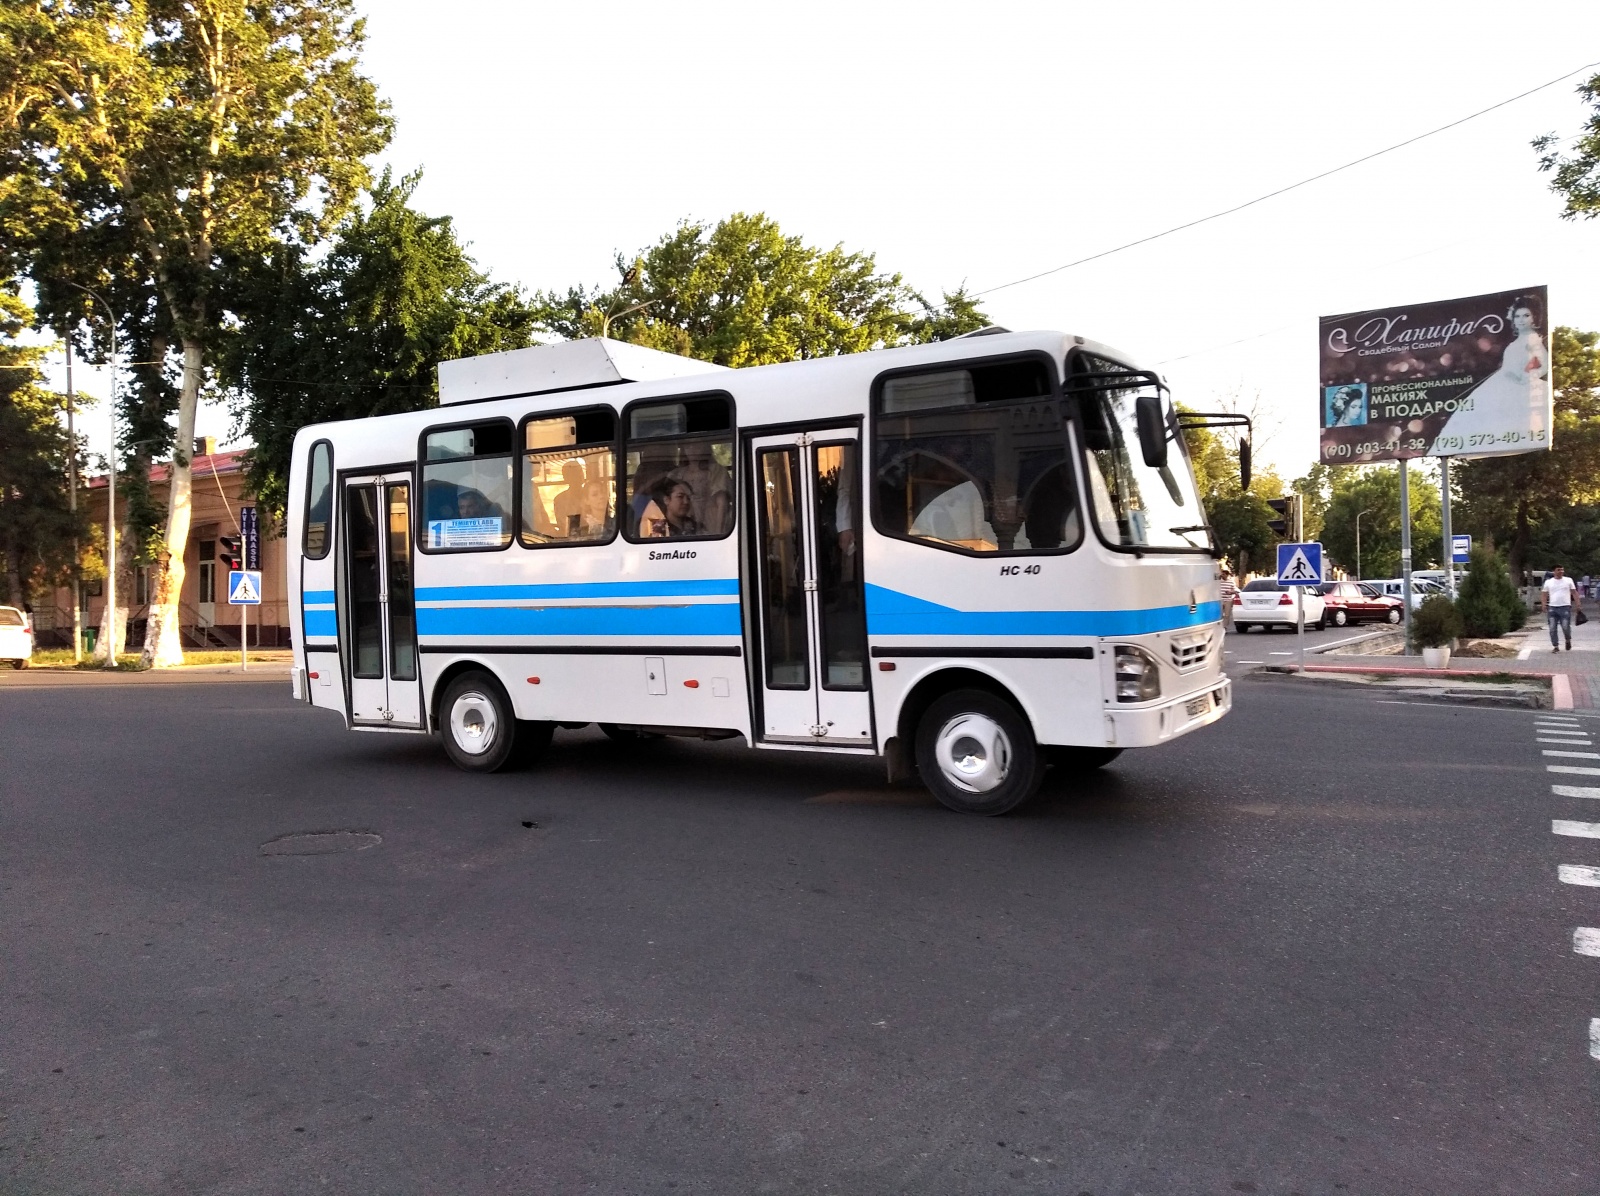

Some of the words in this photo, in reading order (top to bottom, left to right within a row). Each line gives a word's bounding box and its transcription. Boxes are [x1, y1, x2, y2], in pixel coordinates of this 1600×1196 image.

[1354, 314, 1476, 347] Ханифа
[1357, 343, 1410, 357] Свадебный
[1411, 341, 1441, 350] Салон
[1371, 374, 1474, 394] ПРОФЕССИОНАЛЬНЫЙ
[1370, 389, 1428, 405] МАКИЯЖ
[1385, 398, 1475, 418] ПОДАРОК!
[1324, 443, 1352, 459] (90)
[250, 507, 258, 569] AVIAKASSA
[431, 522, 441, 546] 1
[648, 549, 697, 560] SamAuto
[1000, 565, 1021, 576] HC
[1023, 564, 1041, 575] 40
